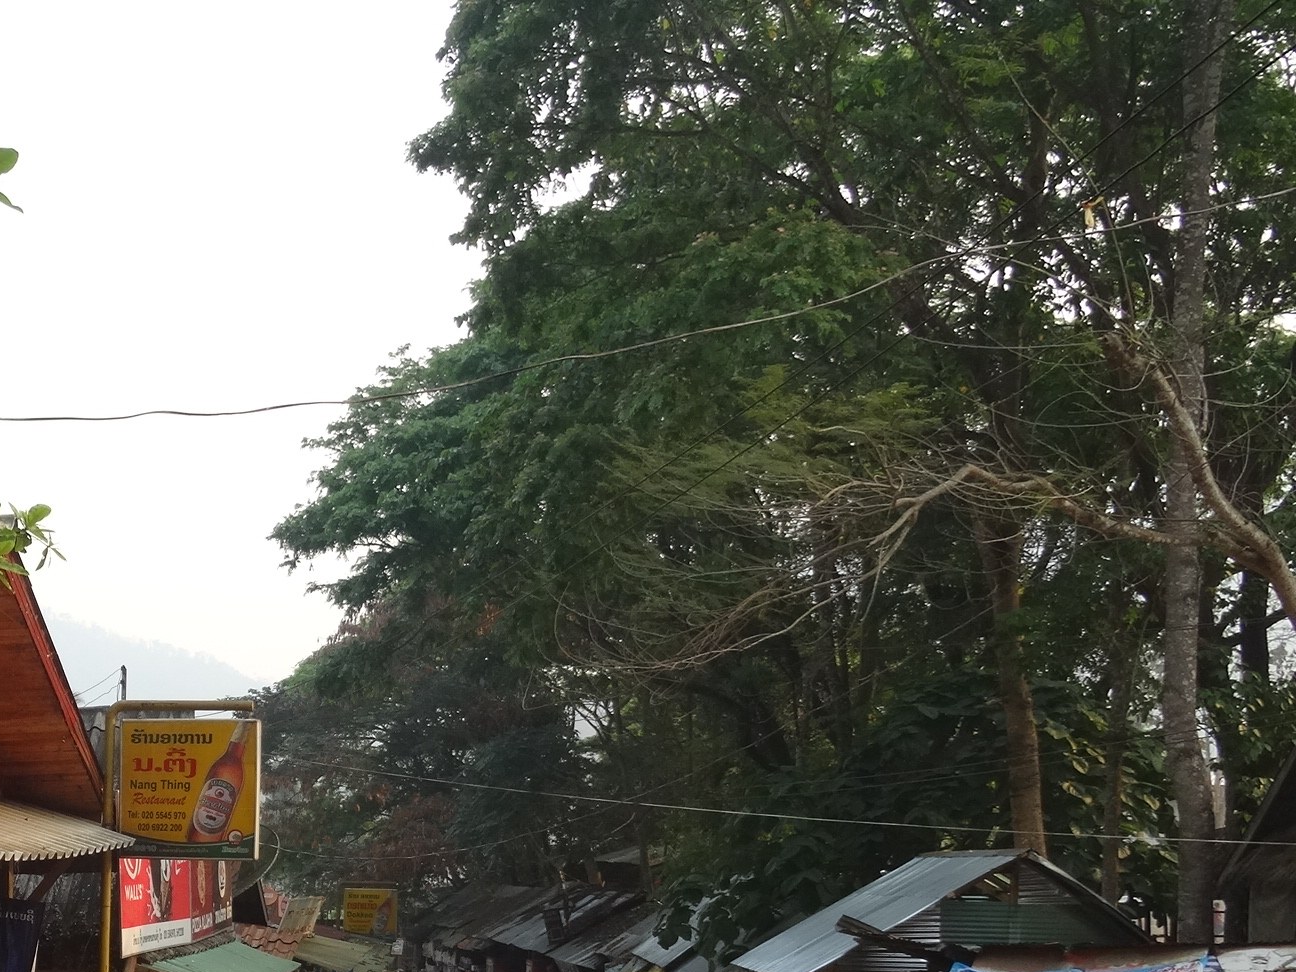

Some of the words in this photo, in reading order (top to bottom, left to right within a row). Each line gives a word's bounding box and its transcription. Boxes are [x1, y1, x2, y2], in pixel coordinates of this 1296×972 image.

[130, 779, 158, 792] Nang
[160, 779, 191, 793] Thing
[131, 791, 187, 807] Restaurant
[127, 810, 141, 820] Tel:
[141, 811, 154, 820] 020
[155, 811, 172, 820] 5545
[173, 811, 186, 820] 970
[137, 823, 150, 832] 020
[169, 823, 183, 832] 200
